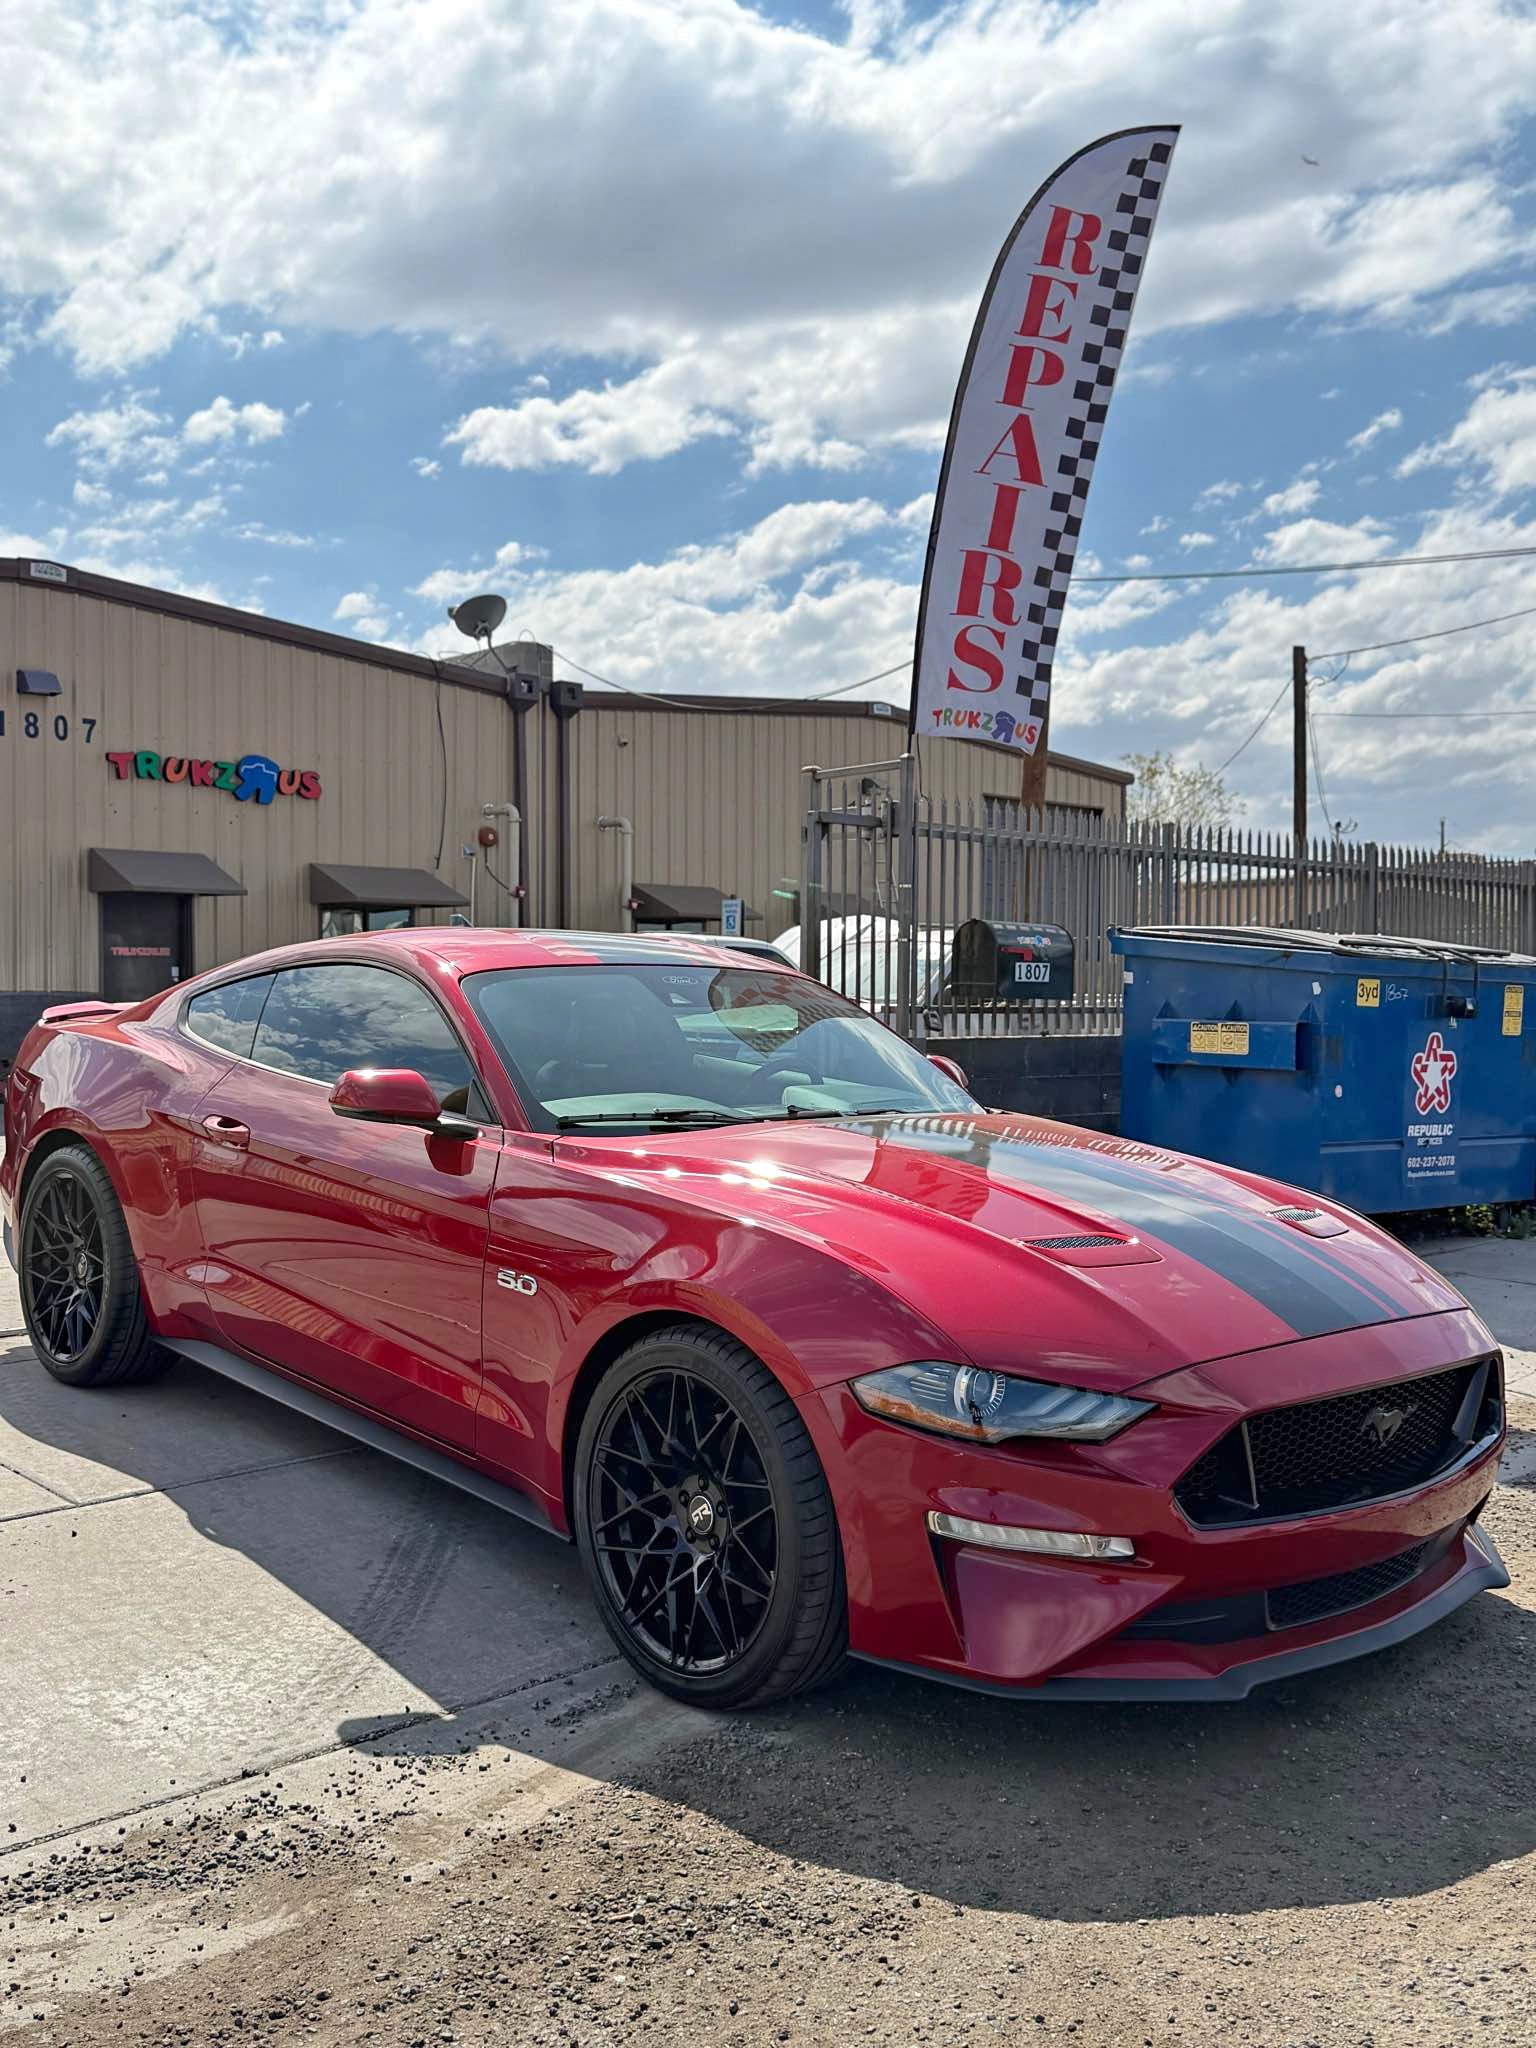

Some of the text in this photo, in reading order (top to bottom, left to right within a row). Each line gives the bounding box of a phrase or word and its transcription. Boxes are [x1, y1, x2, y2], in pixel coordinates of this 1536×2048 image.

[946, 203, 1100, 693] REPAIRS
[106, 751, 237, 792] TRUKZ
[278, 769, 321, 800] US
[1018, 963, 1049, 980] 1807
[1358, 982, 1379, 1002] 3yd
[1407, 1124, 1453, 1137] REPUBLIC
[1416, 1137, 1443, 1146] SEICES
